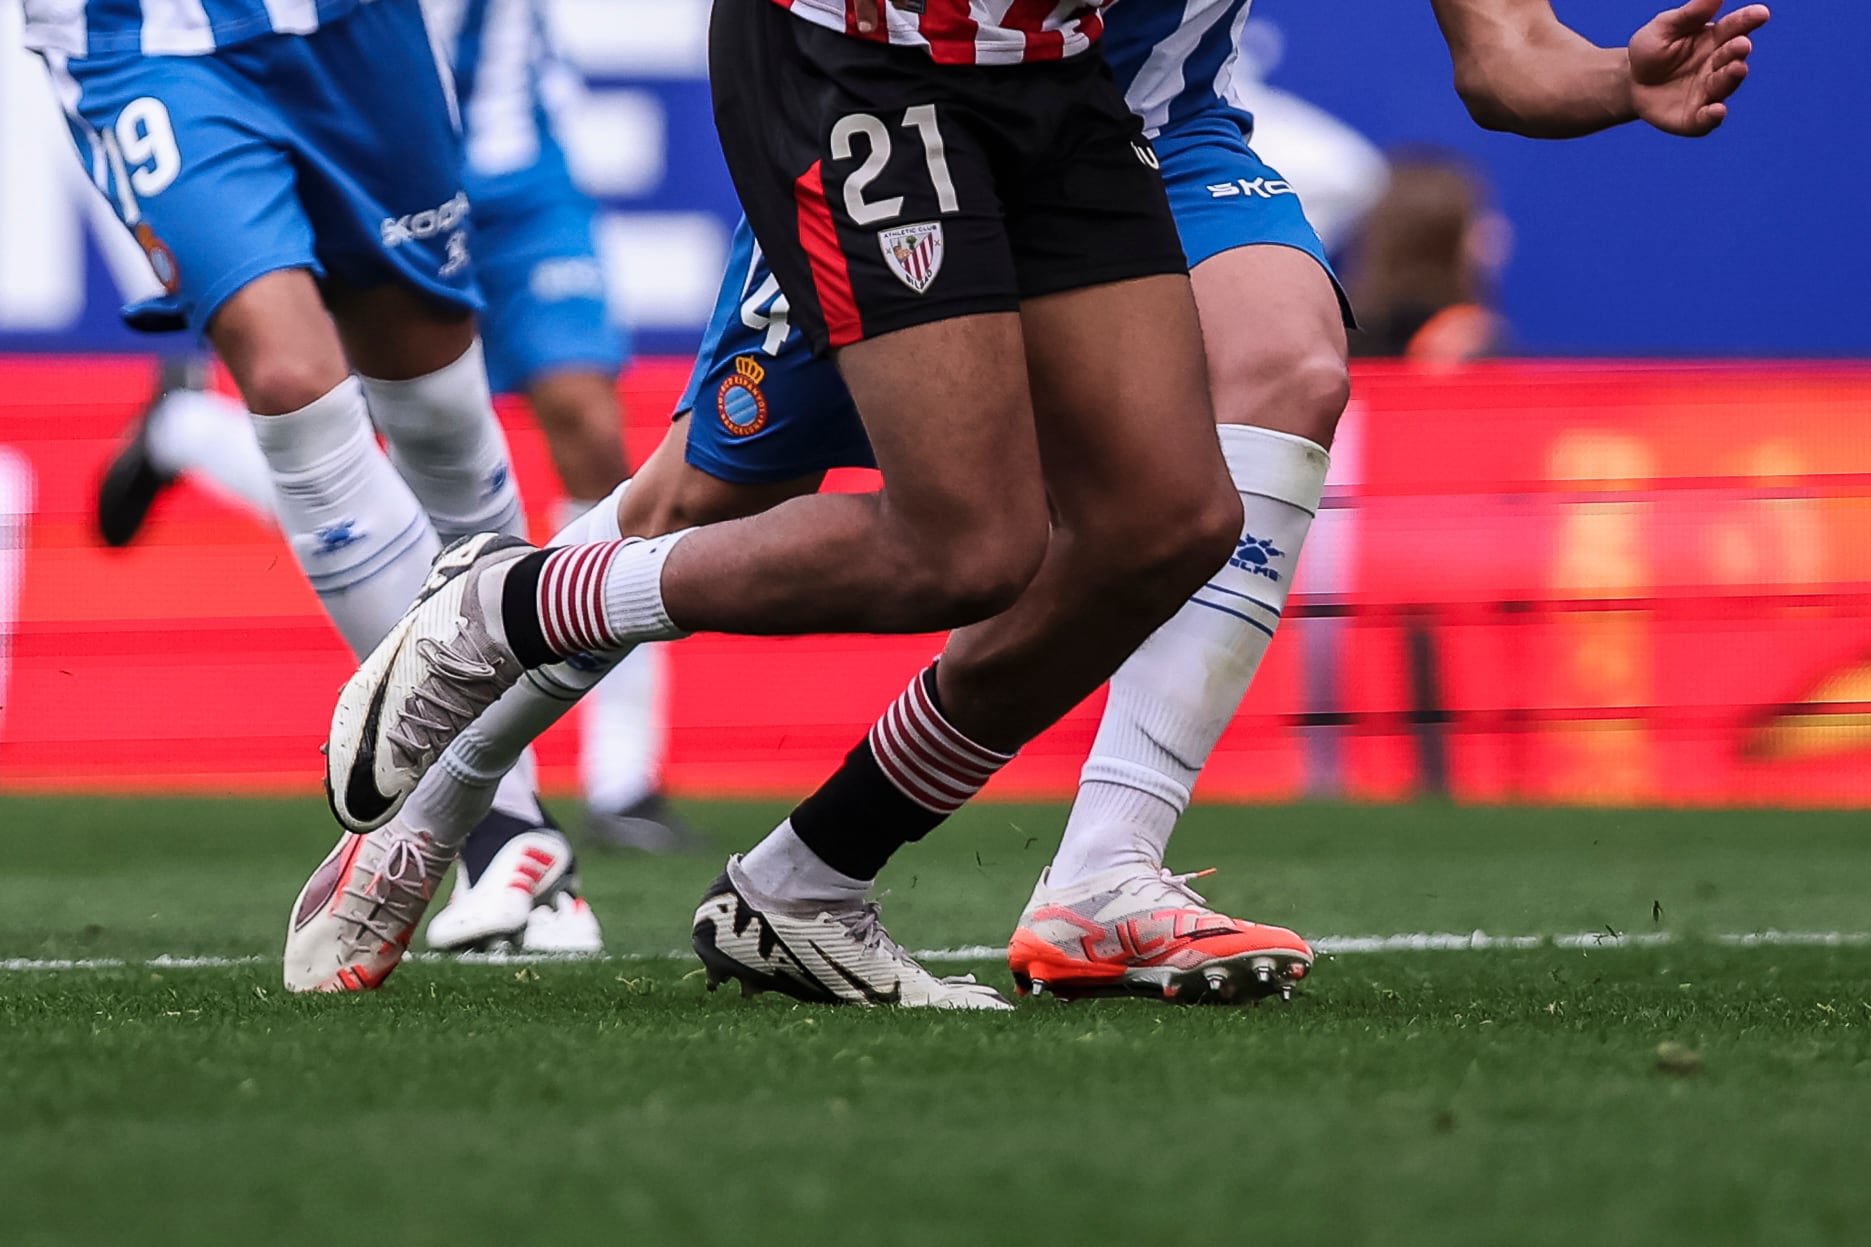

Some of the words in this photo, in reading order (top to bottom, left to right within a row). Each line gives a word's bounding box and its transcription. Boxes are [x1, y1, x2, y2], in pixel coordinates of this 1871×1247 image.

[830, 104, 959, 226] 21
[918, 224, 937, 232] CLUB
[740, 271, 791, 358] 4
